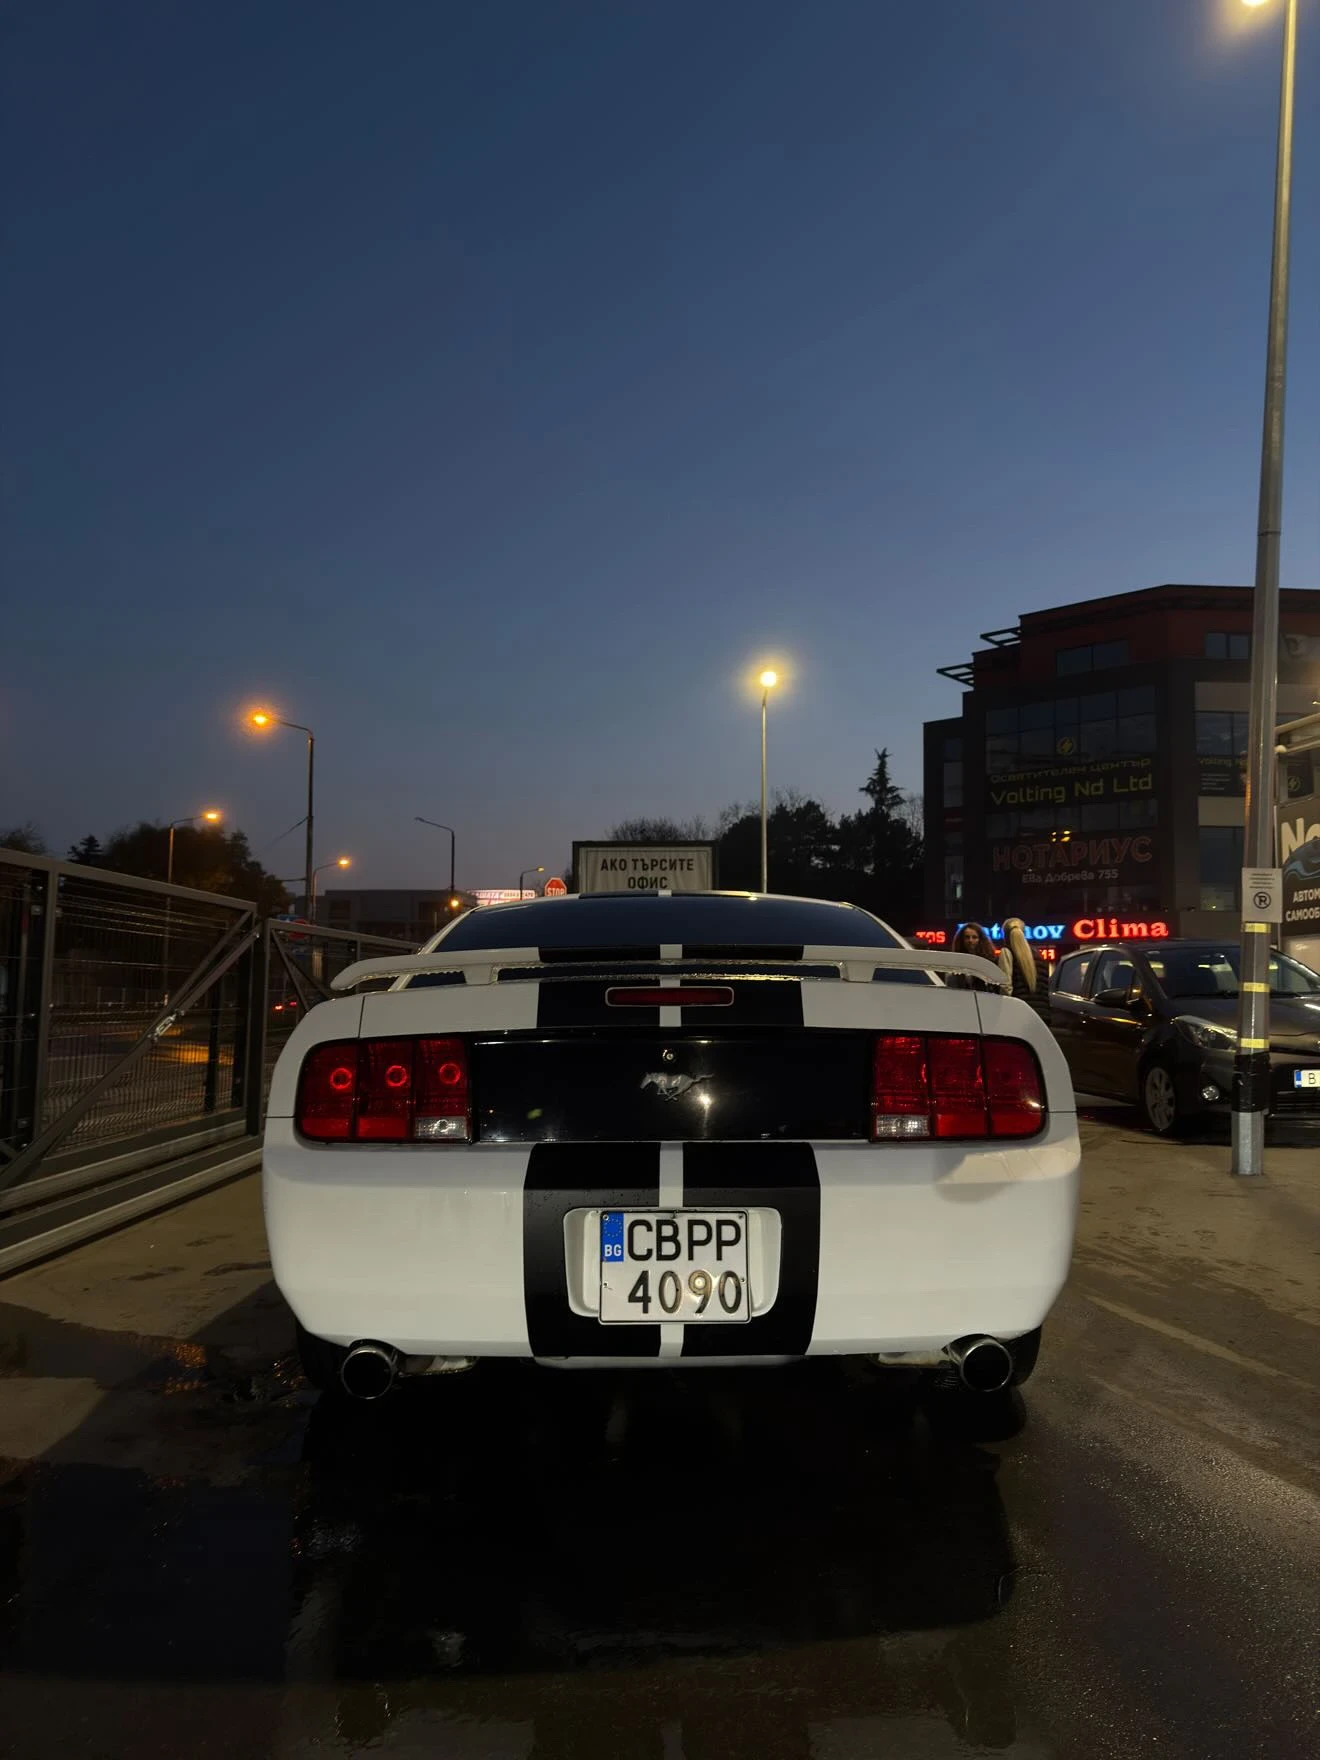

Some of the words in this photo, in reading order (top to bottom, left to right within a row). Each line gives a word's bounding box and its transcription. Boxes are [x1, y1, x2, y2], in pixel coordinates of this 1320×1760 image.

[989, 784, 1066, 806] Volting
[1073, 777, 1105, 798] Nd
[1113, 772, 1153, 793] Ltd
[992, 835, 1153, 872] НОТАРИУС
[601, 858, 628, 872] АКО
[632, 858, 695, 872] ТЪРСИТЕ
[1097, 868, 1119, 880] 755
[627, 876, 669, 889] ОФИС
[547, 887, 565, 897] STOP
[1071, 917, 1170, 940] Clima
[628, 1219, 741, 1261] CBPP
[604, 1244, 622, 1257] BG
[628, 1270, 742, 1314] 4090
